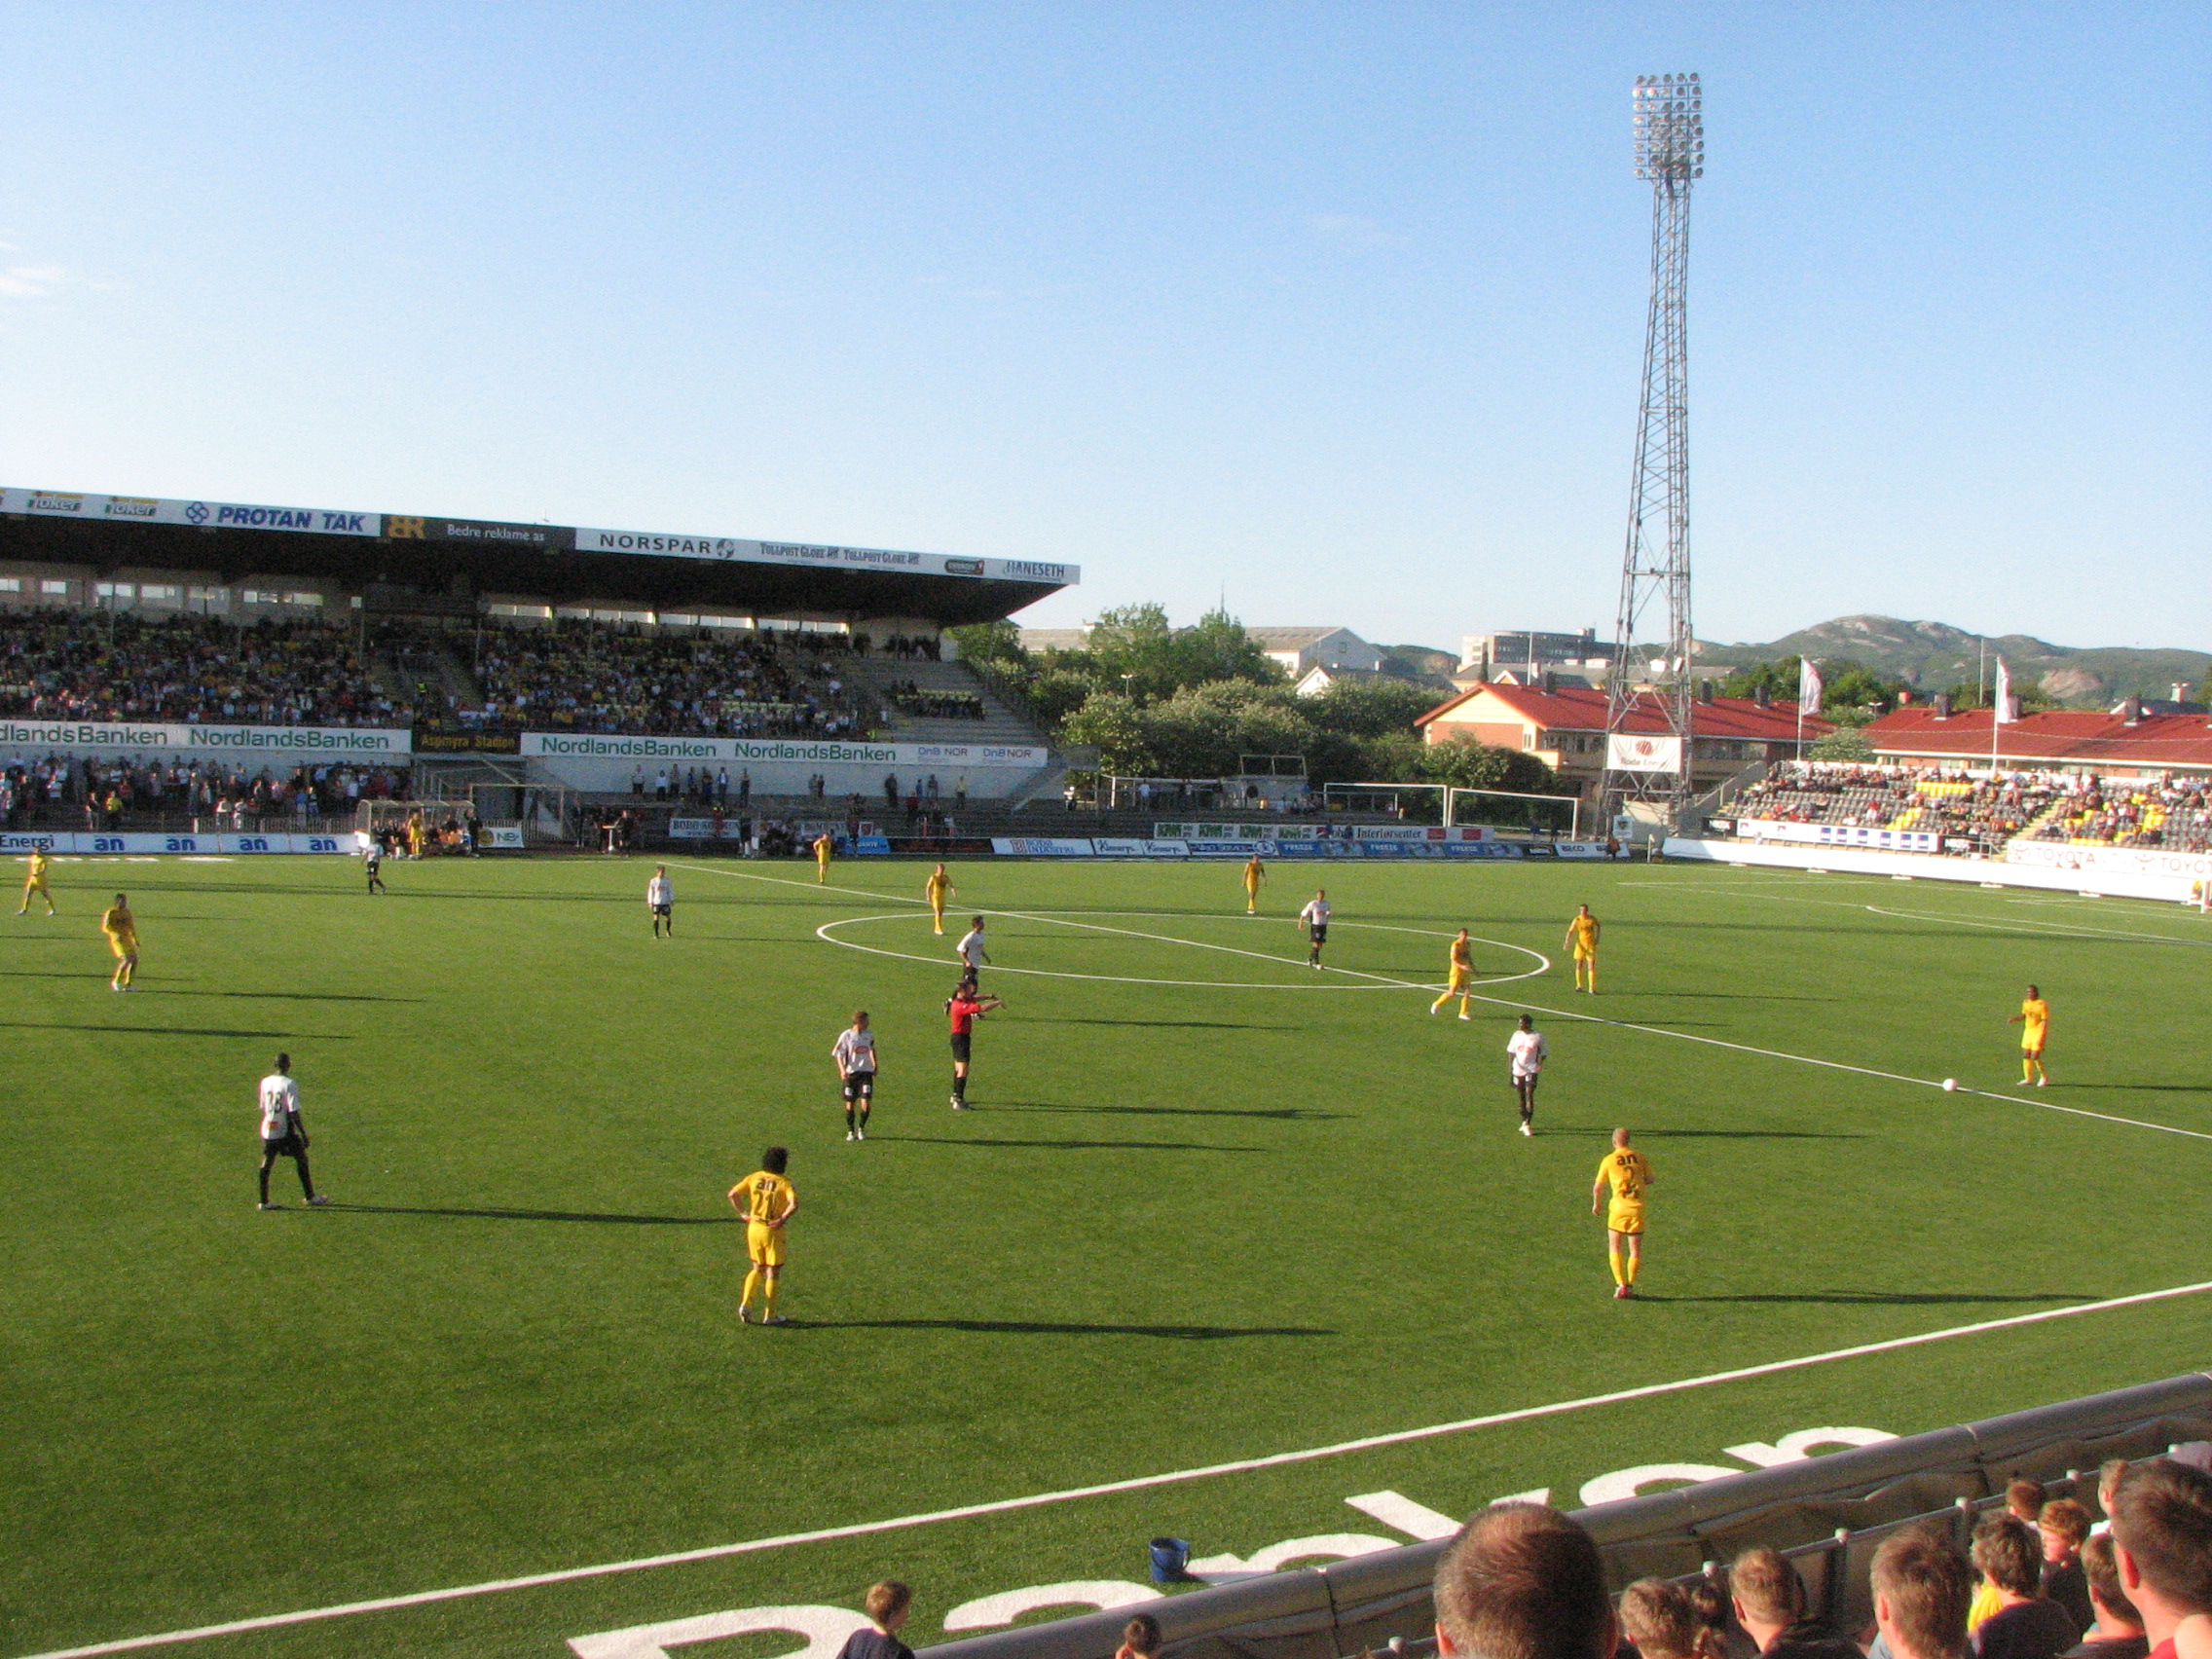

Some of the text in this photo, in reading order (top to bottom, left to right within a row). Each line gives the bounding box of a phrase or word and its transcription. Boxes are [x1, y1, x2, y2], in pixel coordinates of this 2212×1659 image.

[217, 506, 365, 532] PROTAN TAK
[447, 524, 544, 541] Bedre reklame as
[600, 534, 712, 554] NORSPAR
[190, 727, 389, 750] NordlandsBanken
[541, 737, 717, 757] NordlandsBanken
[735, 743, 897, 762] NordlandsBanken
[0, 834, 55, 850] Energi
[2036, 847, 2095, 864] TOYOTA
